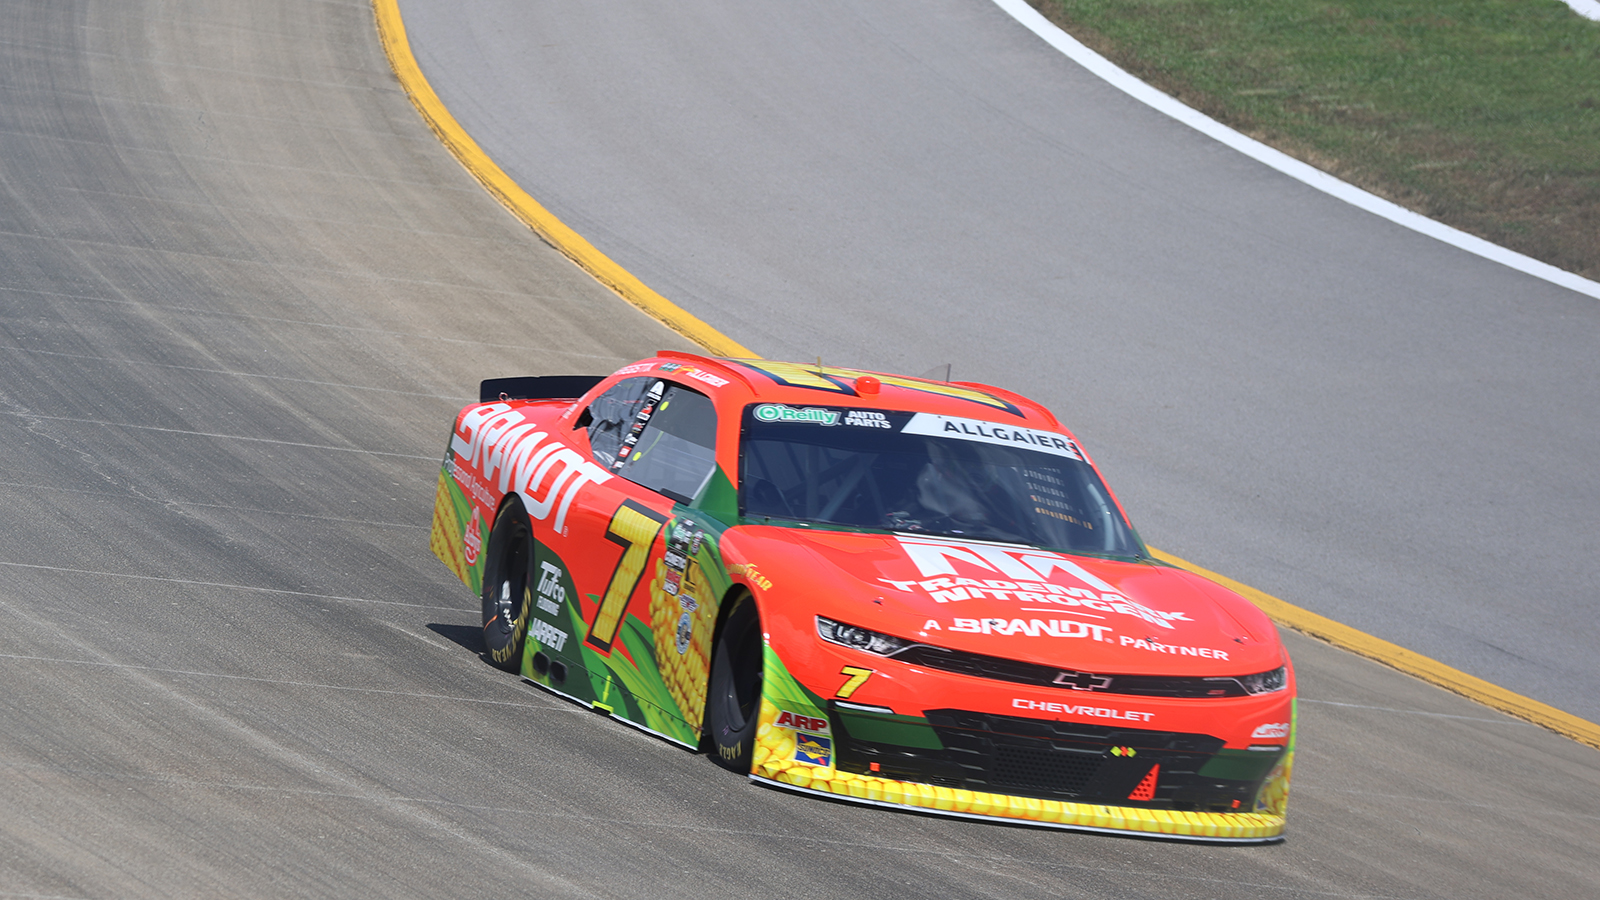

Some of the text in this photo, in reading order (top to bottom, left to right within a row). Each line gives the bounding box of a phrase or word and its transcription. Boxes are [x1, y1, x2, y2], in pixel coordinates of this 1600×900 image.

[757, 404, 837, 424] O'Reilly
[844, 417, 892, 429] PARTS
[847, 410, 886, 420] AUTO
[944, 420, 1071, 452] ALLGAIER
[450, 402, 614, 534] BRANDT
[537, 560, 565, 603] Tufco
[586, 498, 669, 653] 7
[876, 577, 1195, 622] TRADEMARK
[929, 586, 1176, 630] NITROGEN
[528, 617, 569, 652] JARRETT
[923, 617, 1230, 661] A BRANDT PARTNER
[835, 665, 873, 699] 7
[777, 711, 828, 732] ARP
[1012, 698, 1155, 722] CHEVROLET
[719, 740, 742, 762] EAGLE
